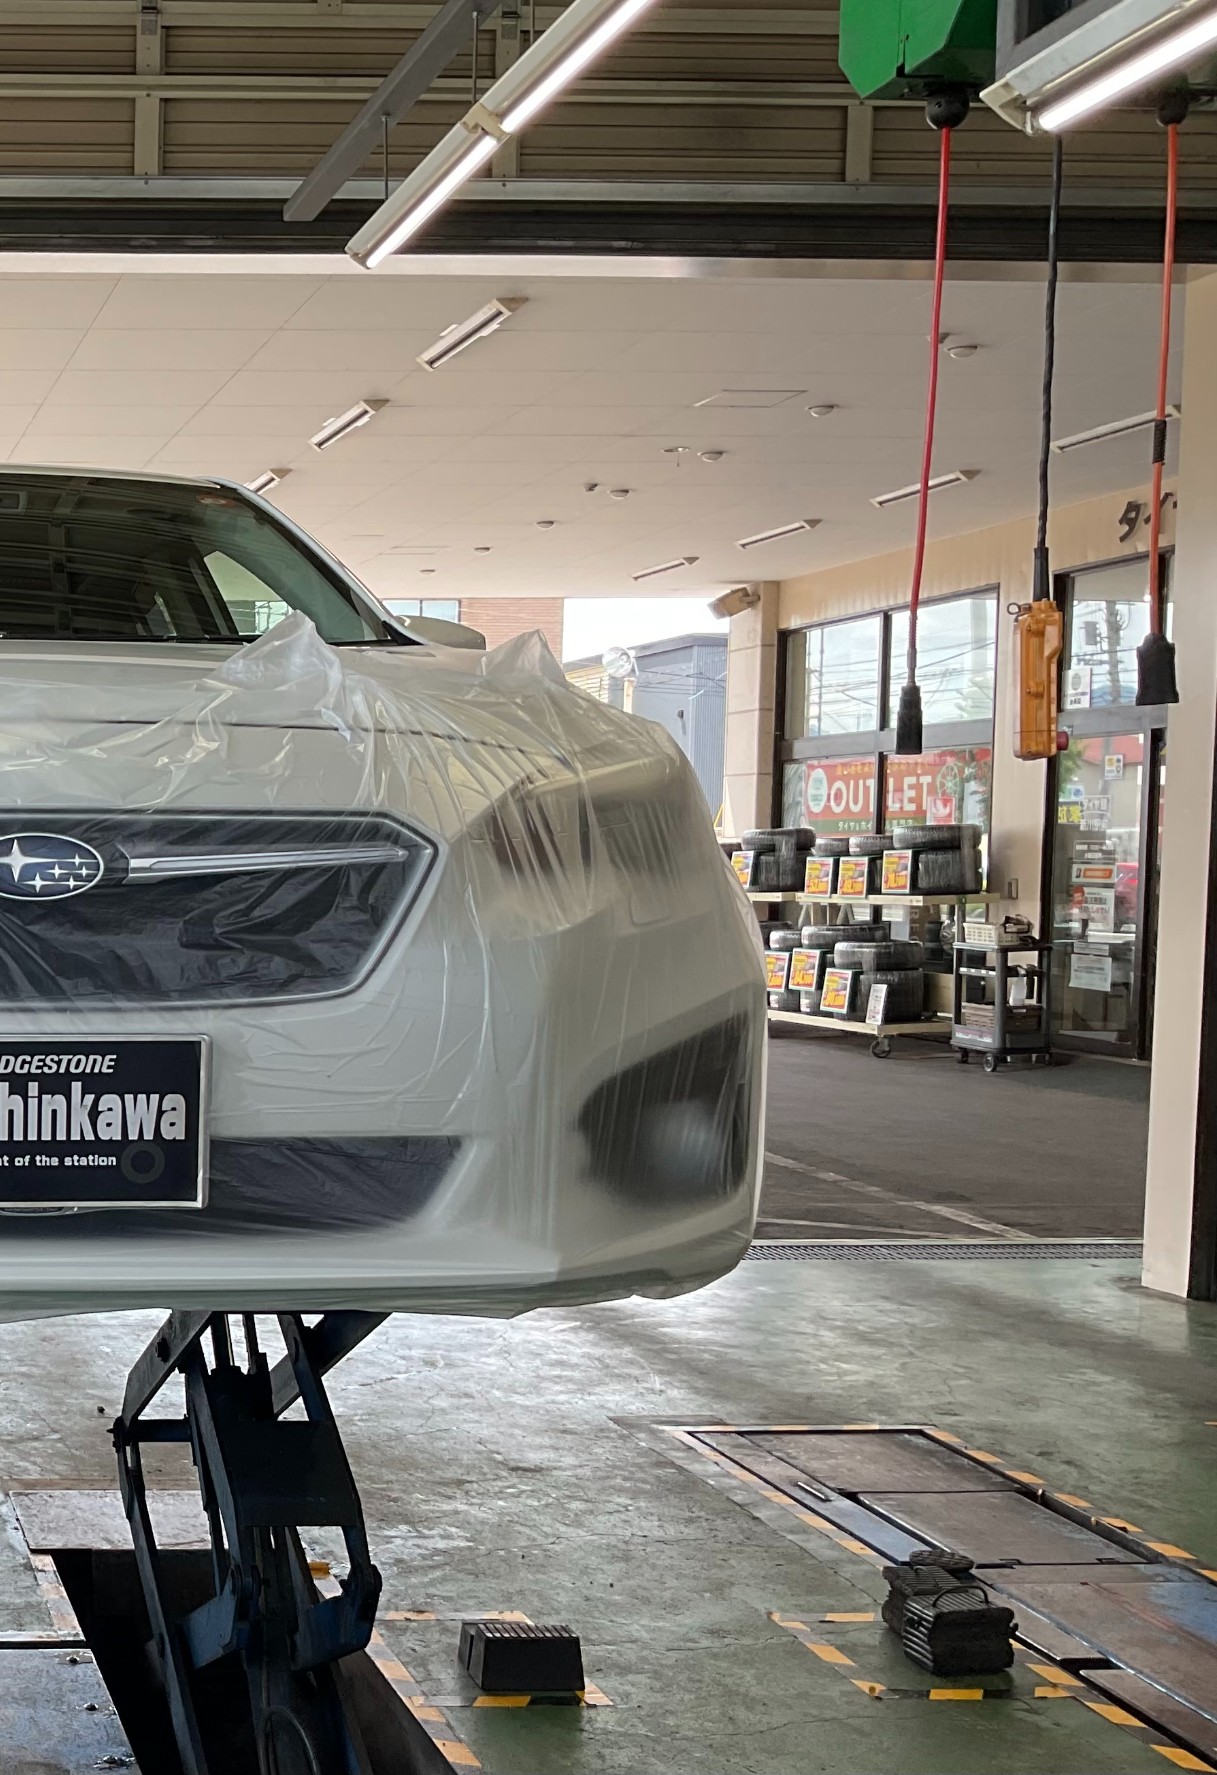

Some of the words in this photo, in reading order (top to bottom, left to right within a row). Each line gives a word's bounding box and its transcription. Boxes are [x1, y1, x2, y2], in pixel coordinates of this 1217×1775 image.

[14, 1155, 31, 1167] of
[35, 1155, 59, 1167] the
[64, 1154, 117, 1167] station
